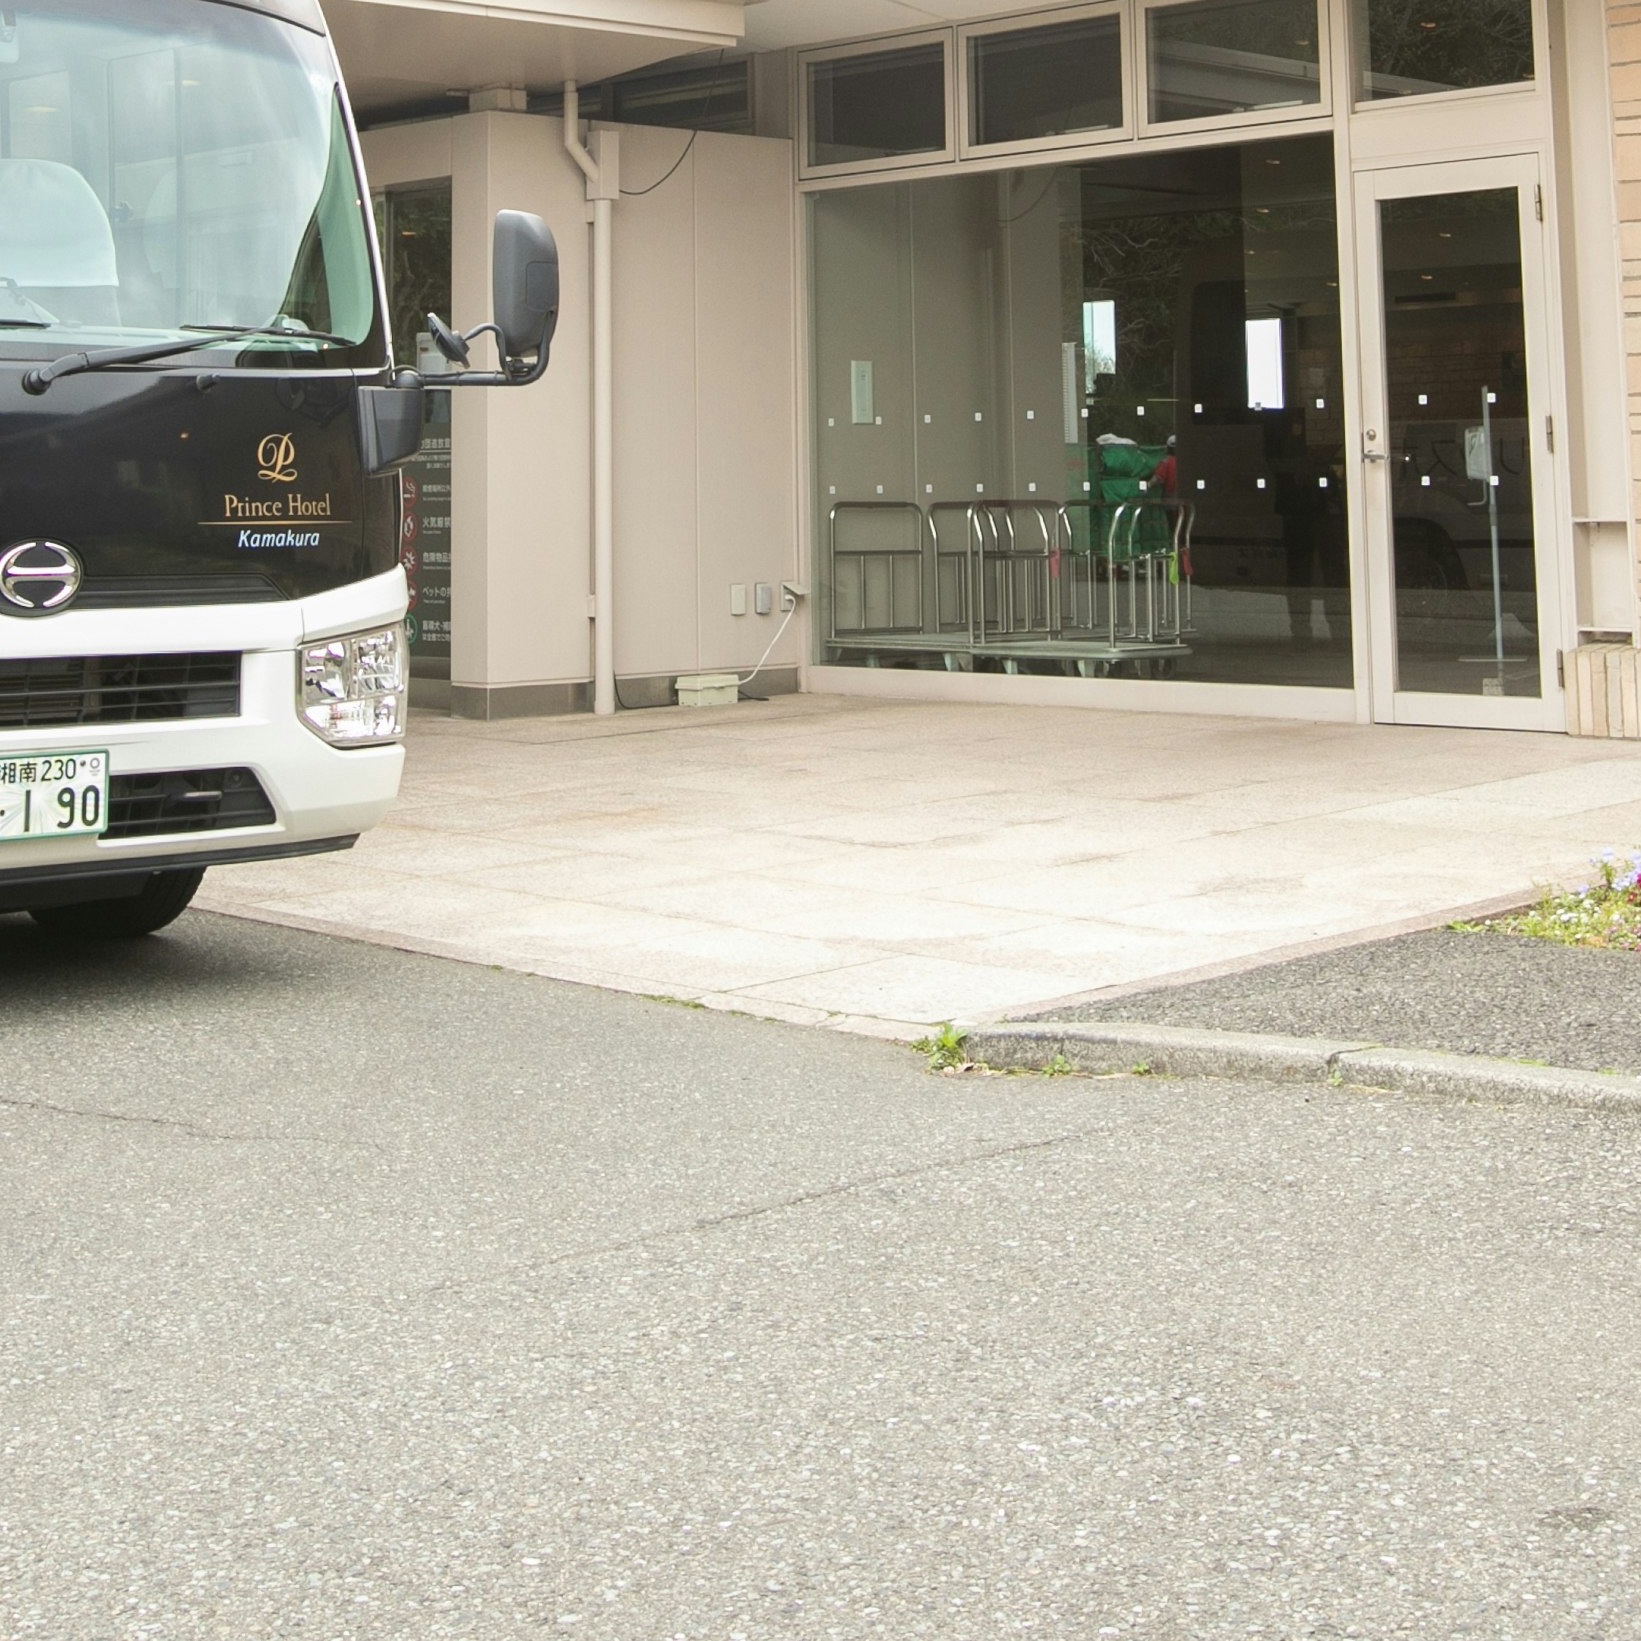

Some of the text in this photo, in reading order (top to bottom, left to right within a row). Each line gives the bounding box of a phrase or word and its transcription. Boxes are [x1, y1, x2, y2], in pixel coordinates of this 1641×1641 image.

[224, 492, 331, 517] Prince Hotel
[237, 529, 320, 548] Kamakura
